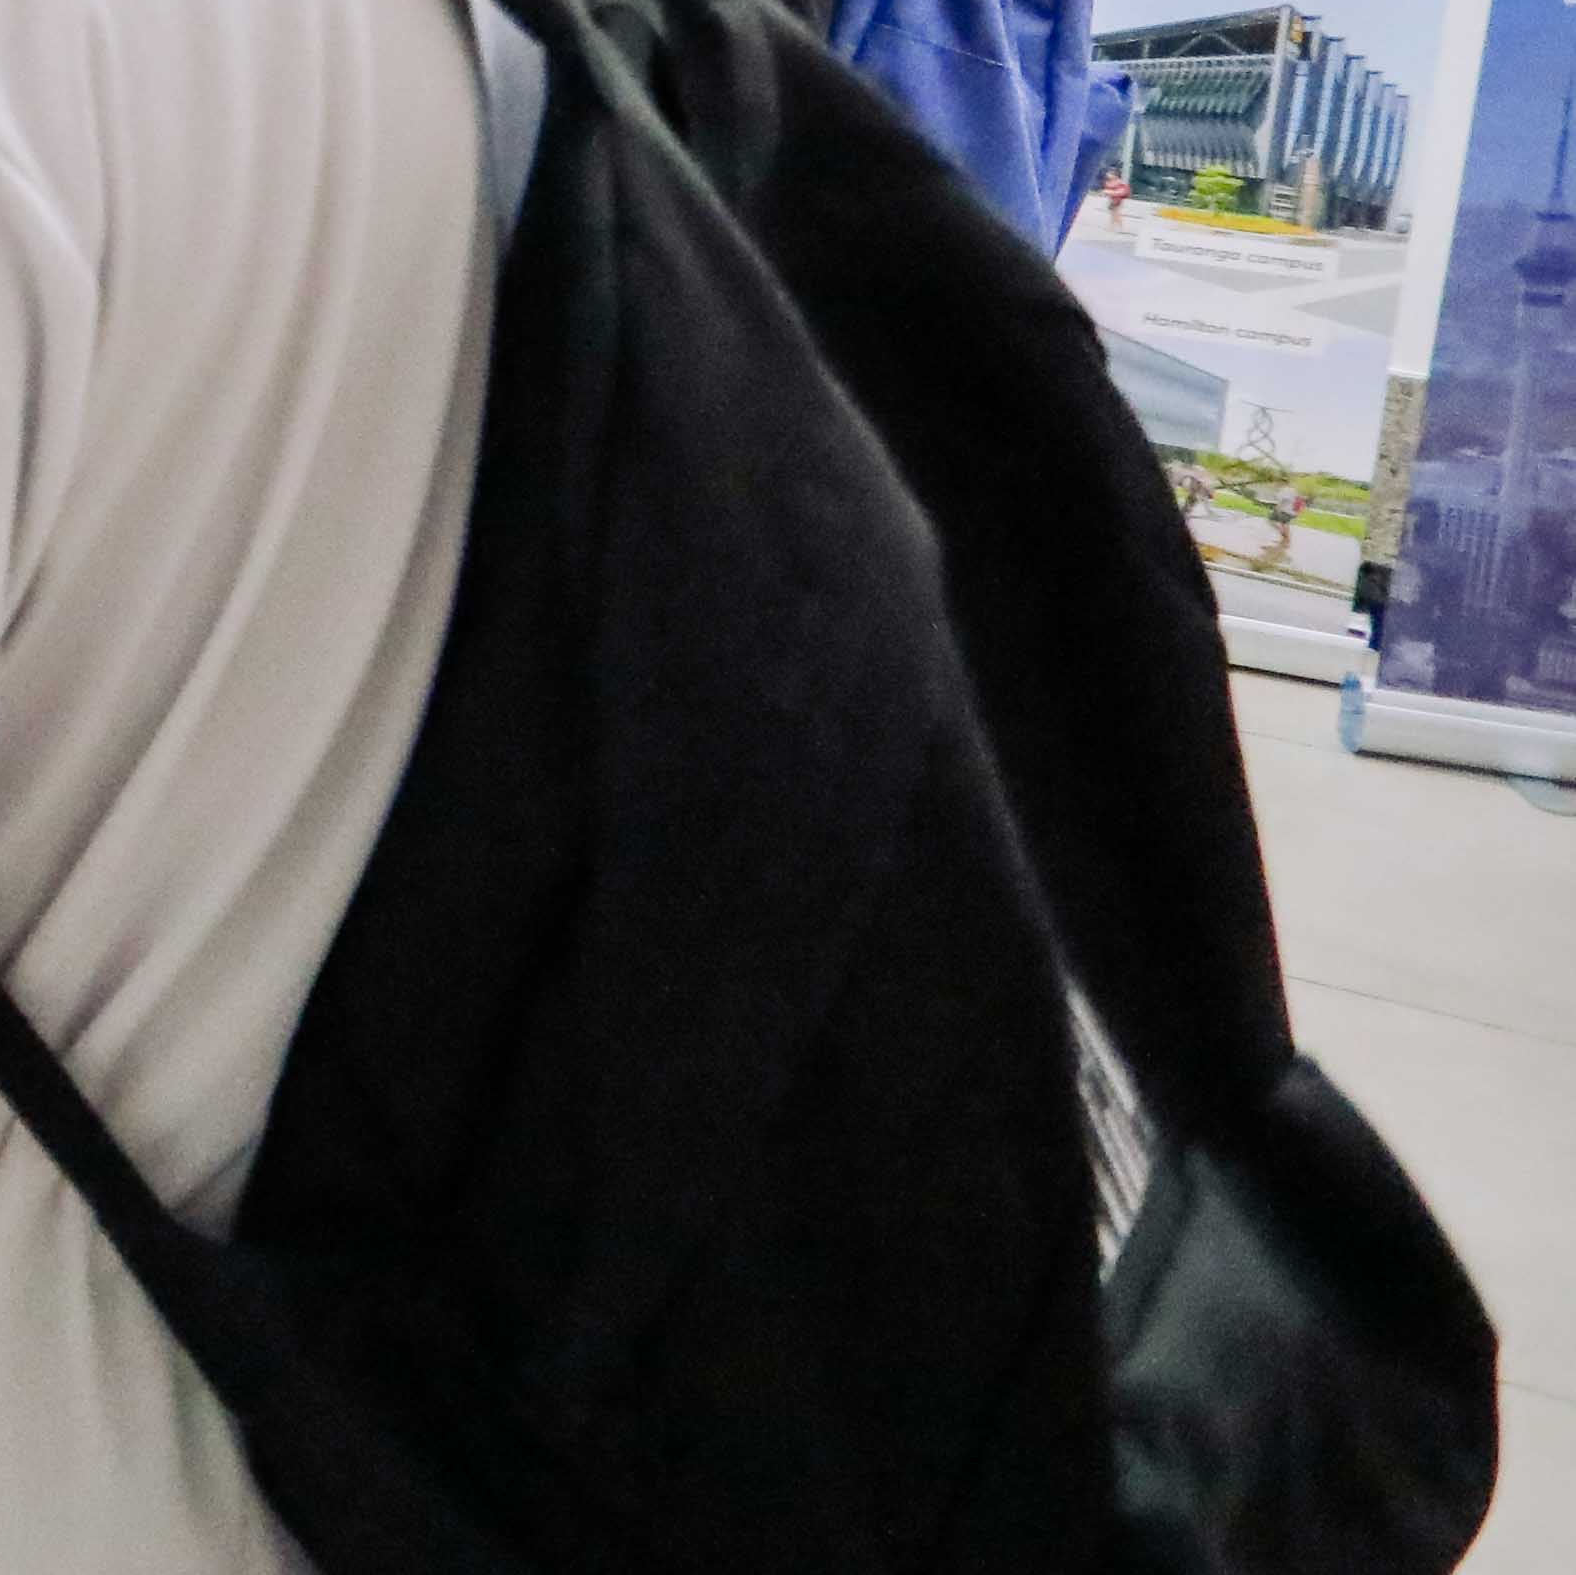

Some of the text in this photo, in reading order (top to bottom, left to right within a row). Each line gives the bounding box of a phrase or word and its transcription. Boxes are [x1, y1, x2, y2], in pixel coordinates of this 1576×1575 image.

[1153, 237, 1324, 272] Tauranga campus
[1143, 312, 1312, 348] Hamilton campus
